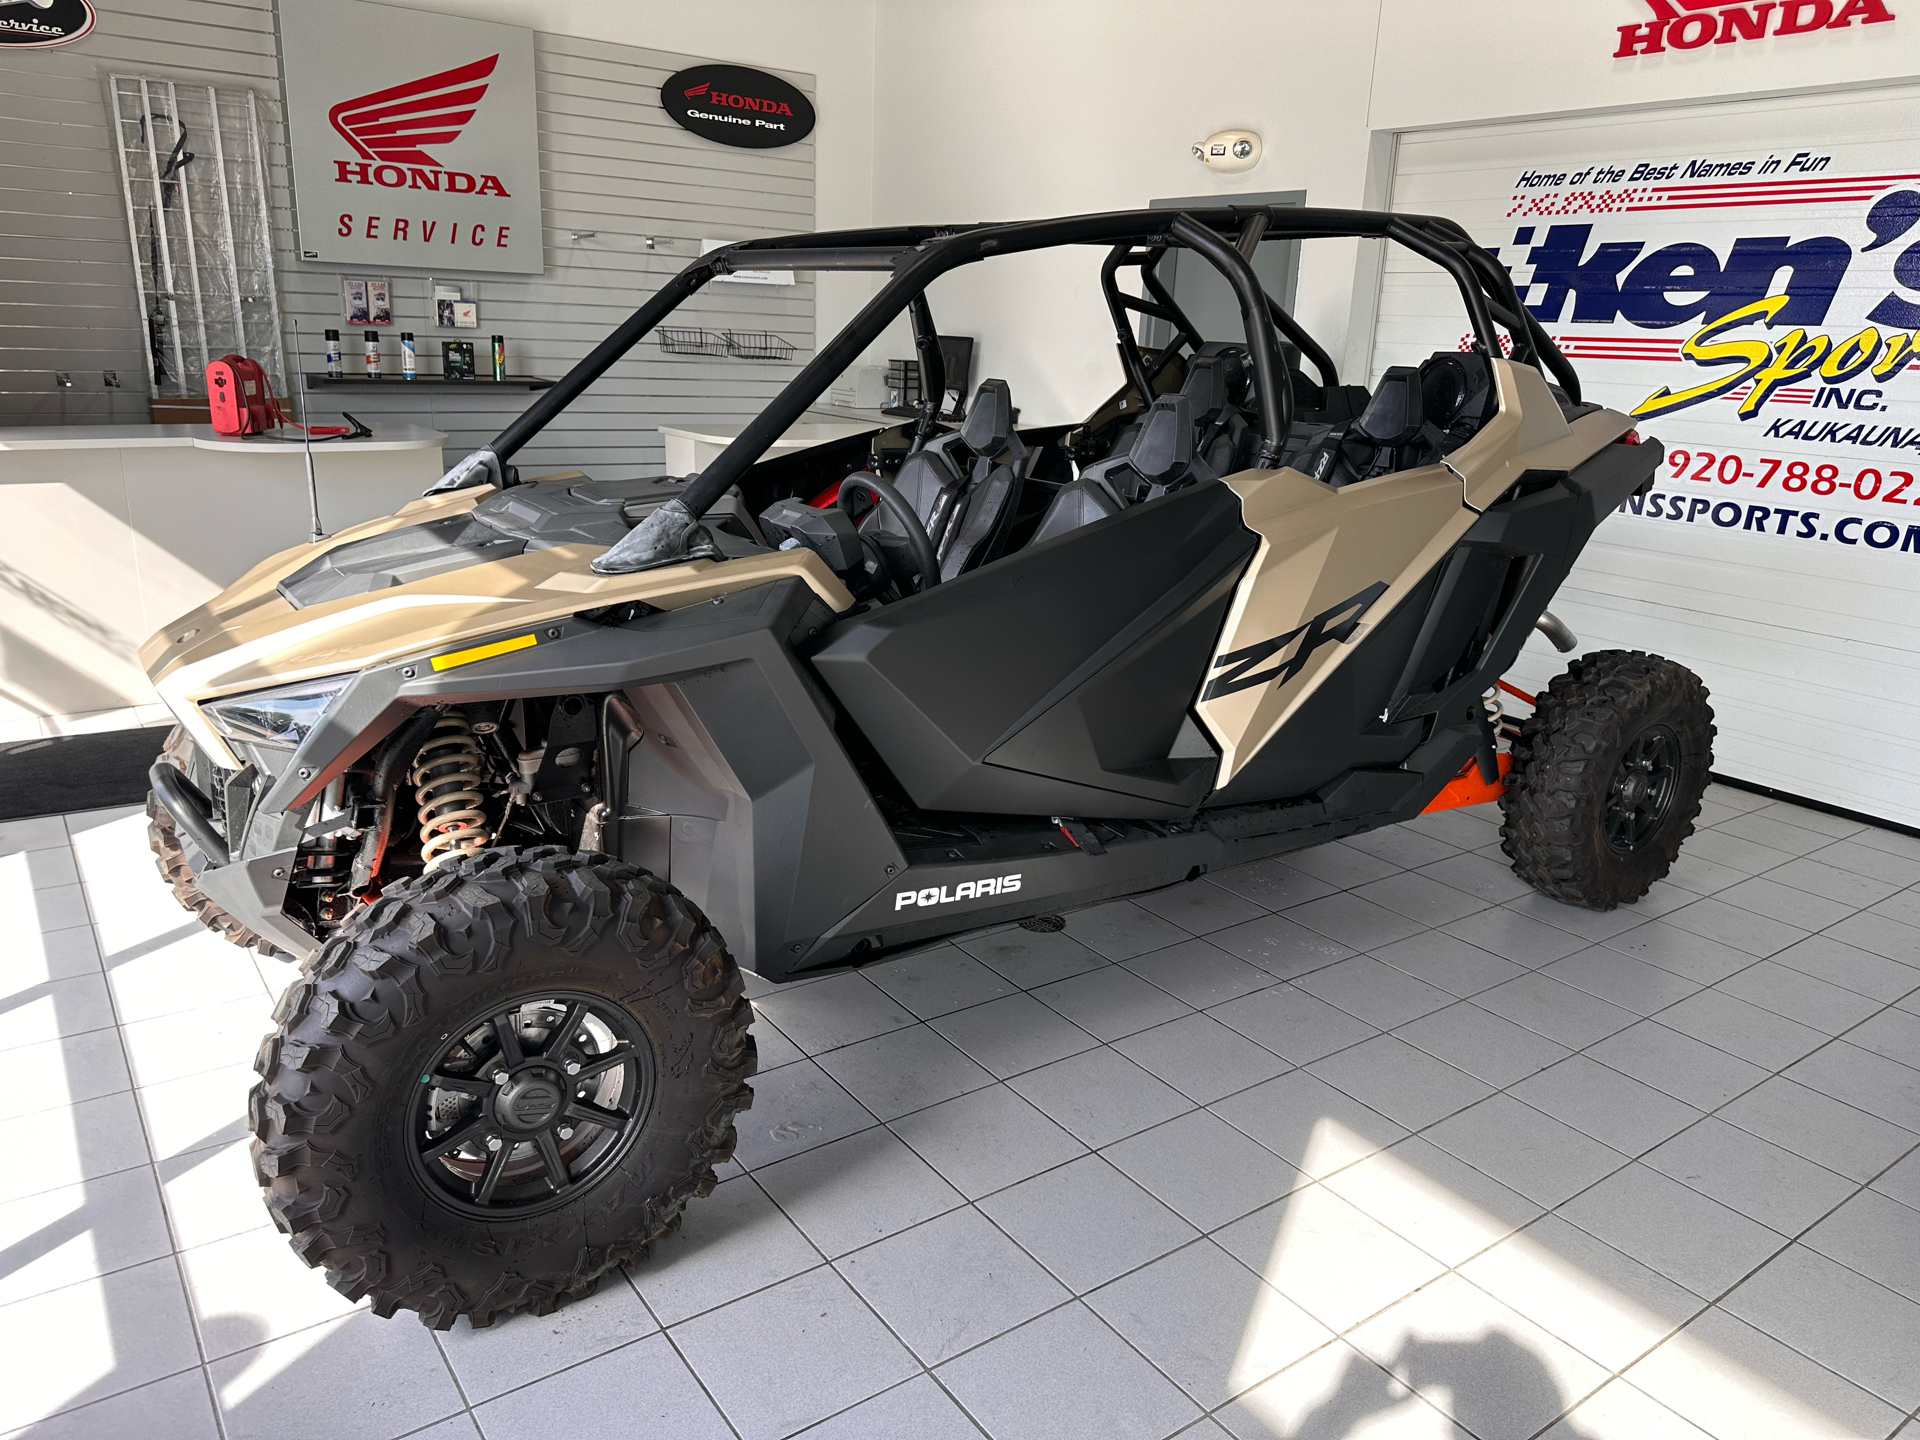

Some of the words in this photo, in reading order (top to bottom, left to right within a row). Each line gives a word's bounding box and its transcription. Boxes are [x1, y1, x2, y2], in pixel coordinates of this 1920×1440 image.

[1613, 0, 1896, 58] HONDA
[686, 109, 752, 126] Genuine
[754, 119, 786, 131] Part
[710, 91, 794, 116] HONDA
[333, 160, 511, 198] HONDA
[1515, 170, 1567, 188] Home
[1569, 166, 1595, 185] of
[1592, 165, 1626, 184] the
[1627, 163, 1680, 182] Best
[1679, 158, 1756, 179] Names
[1757, 154, 1782, 174] in
[1783, 152, 1832, 173] Fun
[337, 213, 511, 248] SERVICE
[1812, 387, 1888, 412] INC.
[1763, 417, 1920, 455] KAUKAUNA
[1667, 449, 1920, 506] 920-788-02
[894, 873, 1022, 911] POLARIS
